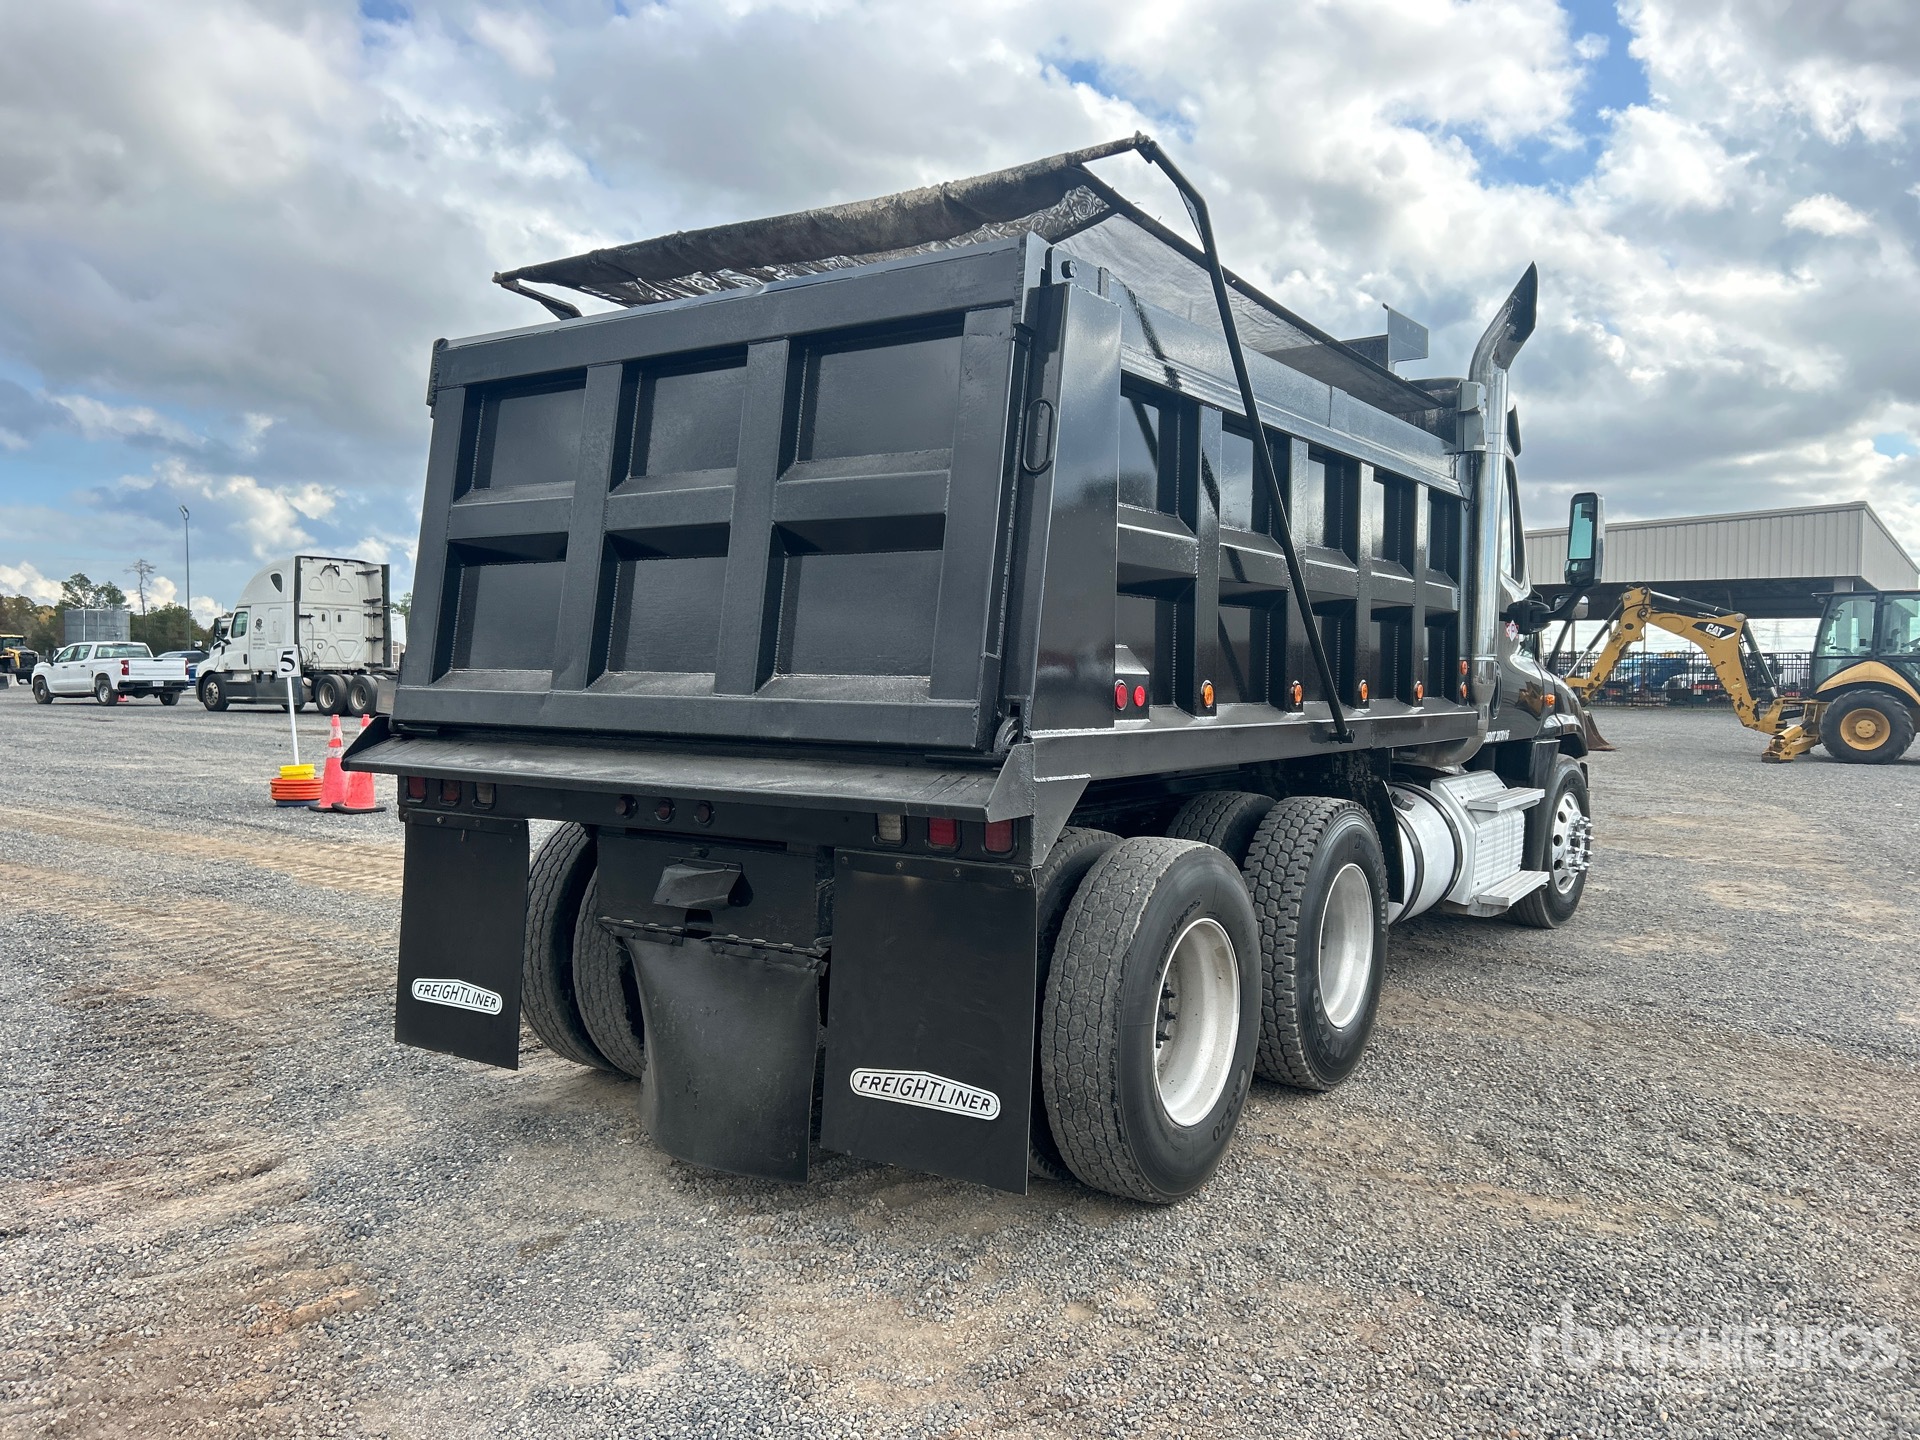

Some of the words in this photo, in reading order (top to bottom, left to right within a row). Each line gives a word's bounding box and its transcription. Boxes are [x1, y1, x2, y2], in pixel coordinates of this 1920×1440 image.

[1705, 623, 1726, 637] CAT
[280, 650, 296, 672] 5
[417, 984, 497, 1009] FREIGHTLINER
[859, 1075, 991, 1112] FREIGHTLINER
